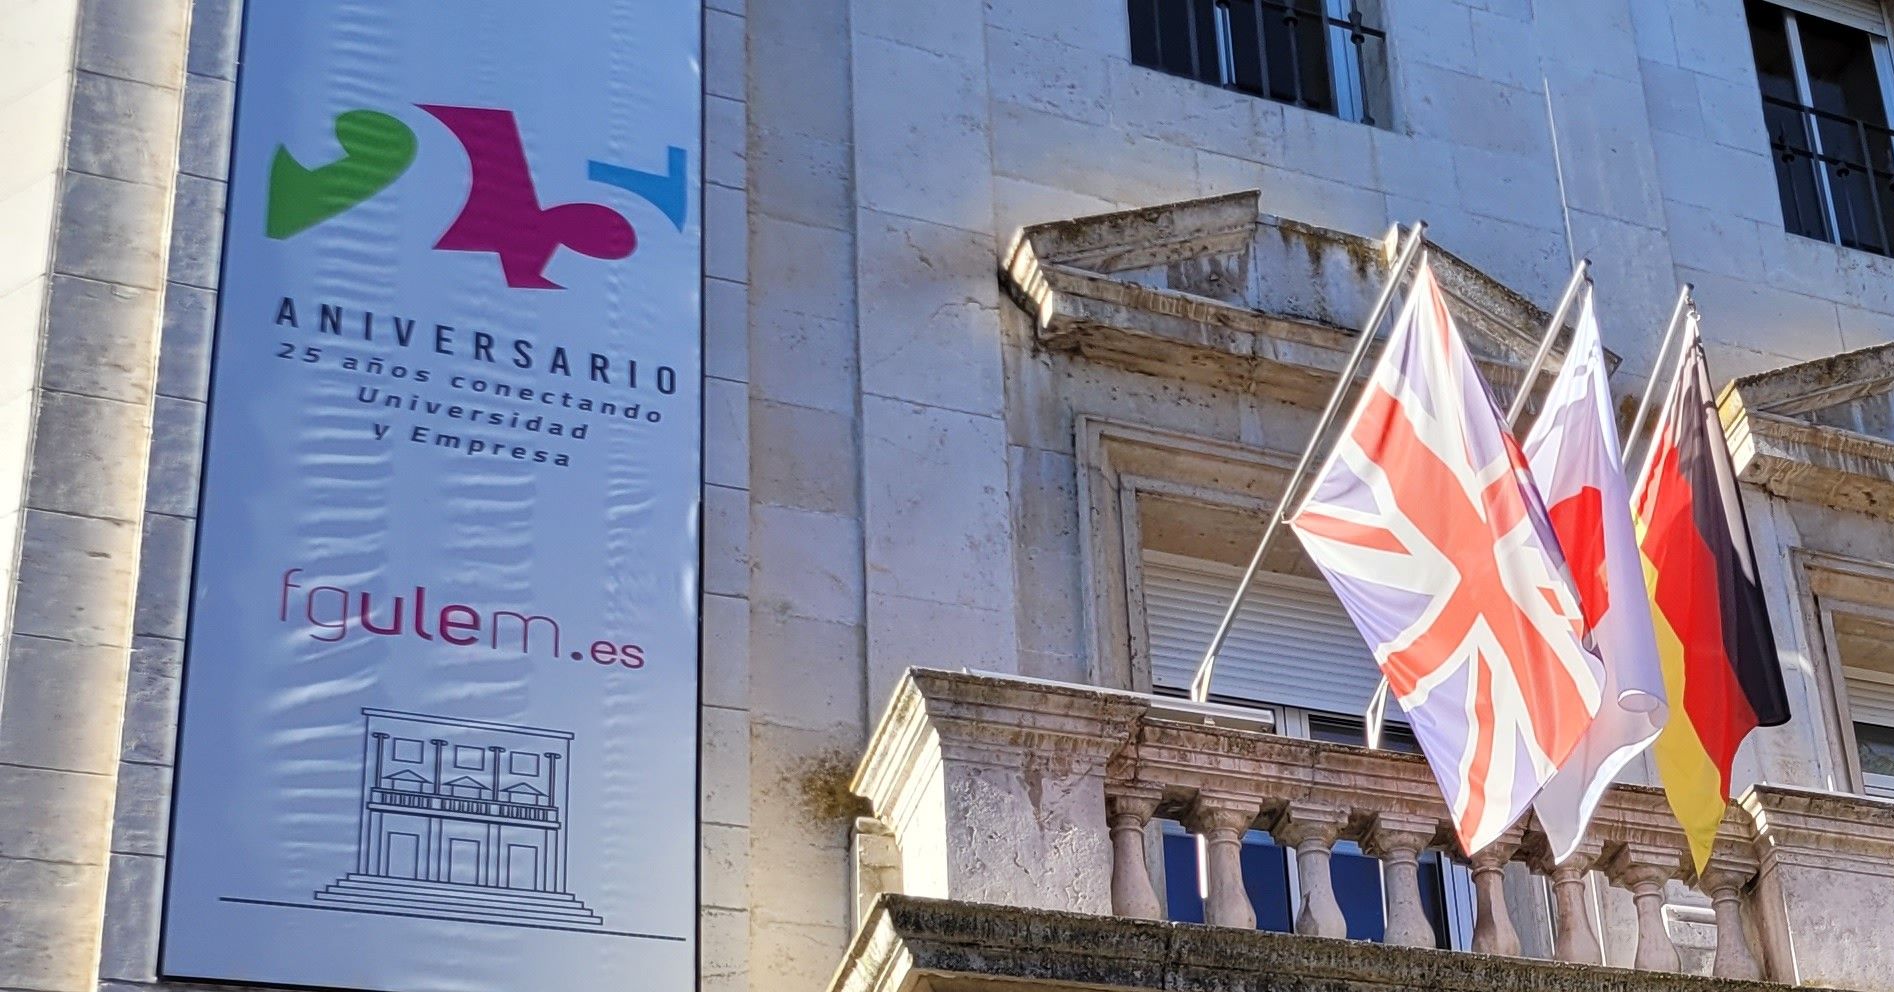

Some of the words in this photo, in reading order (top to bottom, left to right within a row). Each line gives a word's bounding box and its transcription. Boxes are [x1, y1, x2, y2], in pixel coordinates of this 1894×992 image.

[275, 297, 678, 396] ANIVERSARIO
[276, 342, 323, 365] 25
[343, 351, 432, 385] años
[451, 374, 663, 424] conectando
[358, 386, 590, 441] Universidad
[373, 422, 391, 441] y
[411, 425, 572, 468] Empresa
[279, 567, 646, 670] fgulem.es
